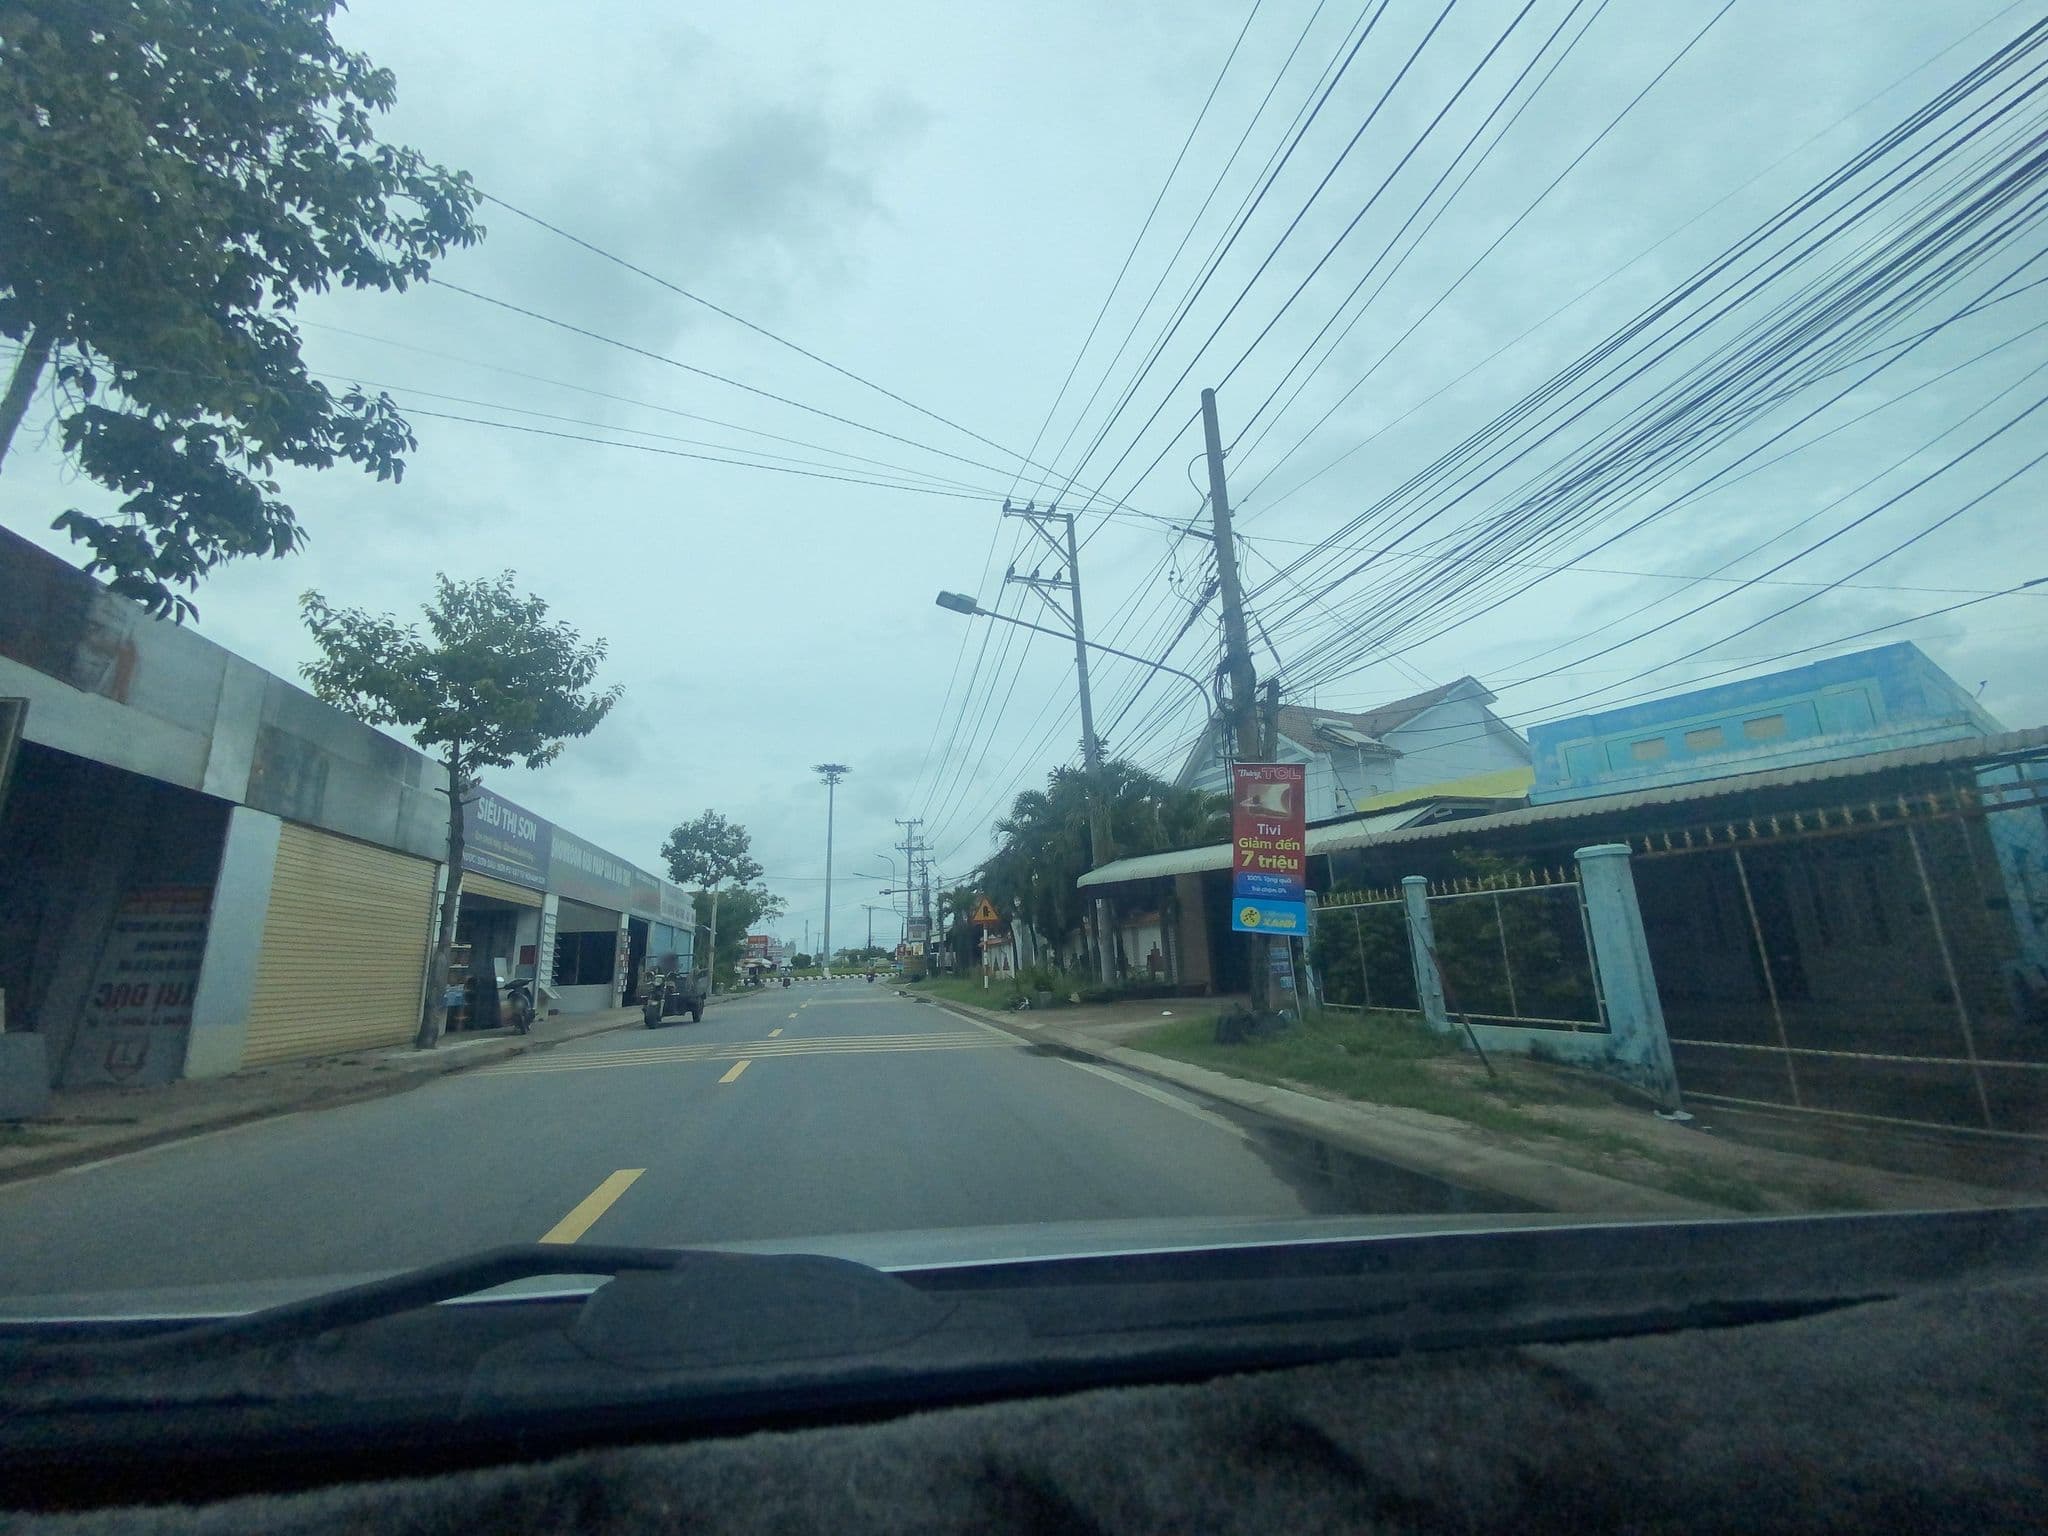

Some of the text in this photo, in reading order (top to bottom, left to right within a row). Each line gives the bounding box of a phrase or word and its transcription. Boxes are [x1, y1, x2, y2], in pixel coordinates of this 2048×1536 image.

[1262, 767, 1302, 780] TCL
[502, 808, 518, 839] THỊ
[1257, 823, 1281, 836] Tivi
[1238, 837, 1301, 851] Giảm đến
[1241, 850, 1298, 873] 7 triệu
